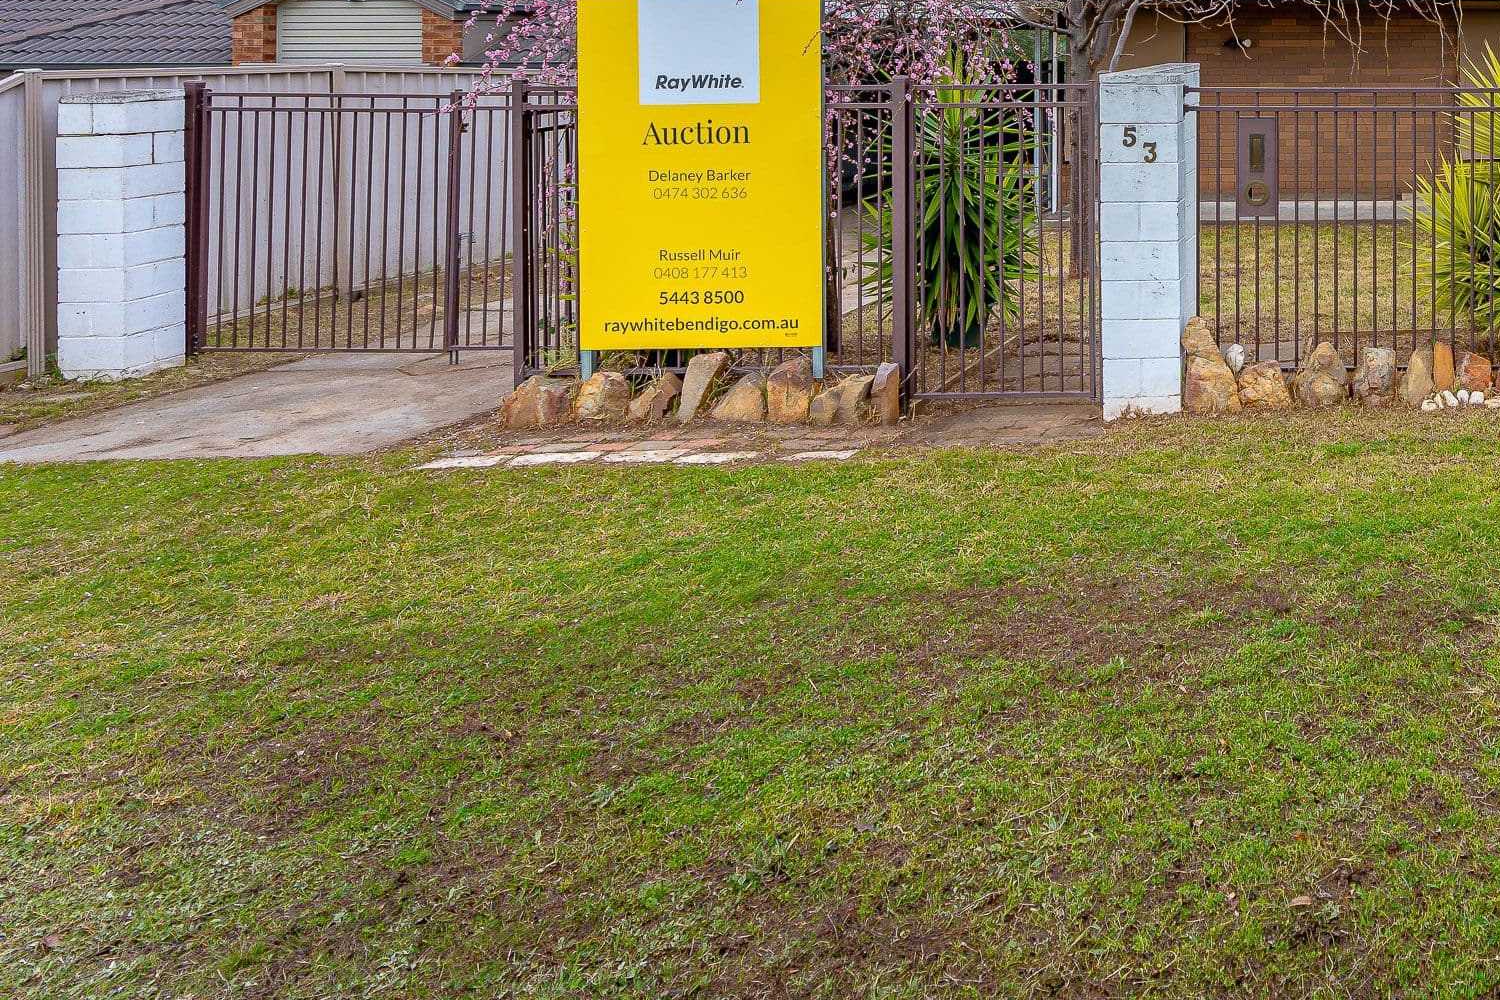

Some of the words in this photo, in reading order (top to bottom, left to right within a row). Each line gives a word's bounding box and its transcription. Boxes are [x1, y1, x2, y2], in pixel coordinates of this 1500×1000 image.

[642, 119, 751, 146] Auction
[648, 169, 704, 185] Delaney
[707, 169, 751, 182] Barker
[653, 186, 689, 200] 0474
[692, 186, 718, 200] 302
[721, 186, 747, 200] 636
[659, 249, 705, 261] Russell
[709, 249, 741, 261] Muir
[653, 266, 689, 280] 0408
[693, 266, 717, 280] 177
[721, 266, 747, 279] 413
[659, 290, 700, 305] 5443
[703, 290, 745, 305] 8500
[604, 316, 799, 334] raywhitebendigo.com.au
